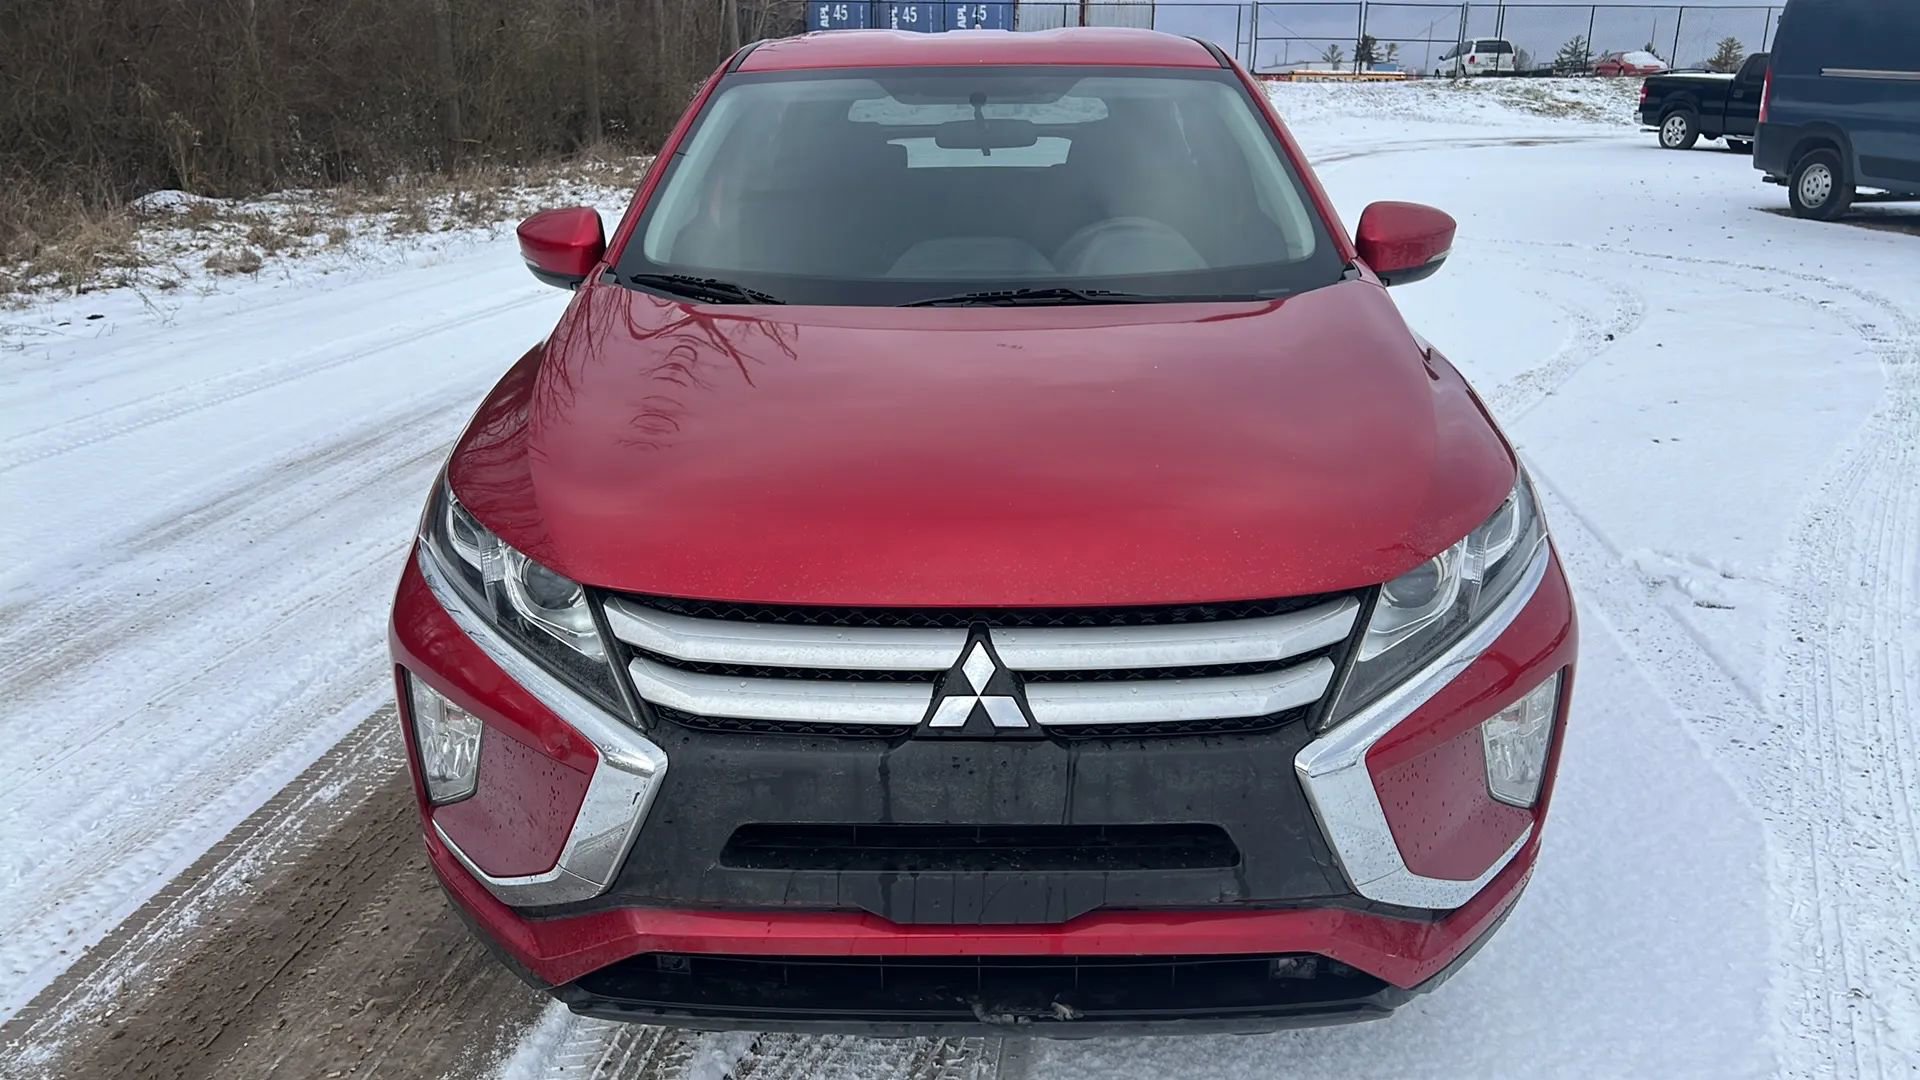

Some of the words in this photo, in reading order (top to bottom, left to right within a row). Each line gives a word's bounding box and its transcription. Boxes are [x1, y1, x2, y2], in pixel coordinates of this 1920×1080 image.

[820, 4, 829, 27] APL
[833, 5, 848, 20] 45
[902, 6, 917, 23] 45
[957, 5, 967, 29] APL
[972, 5, 987, 21] 45
